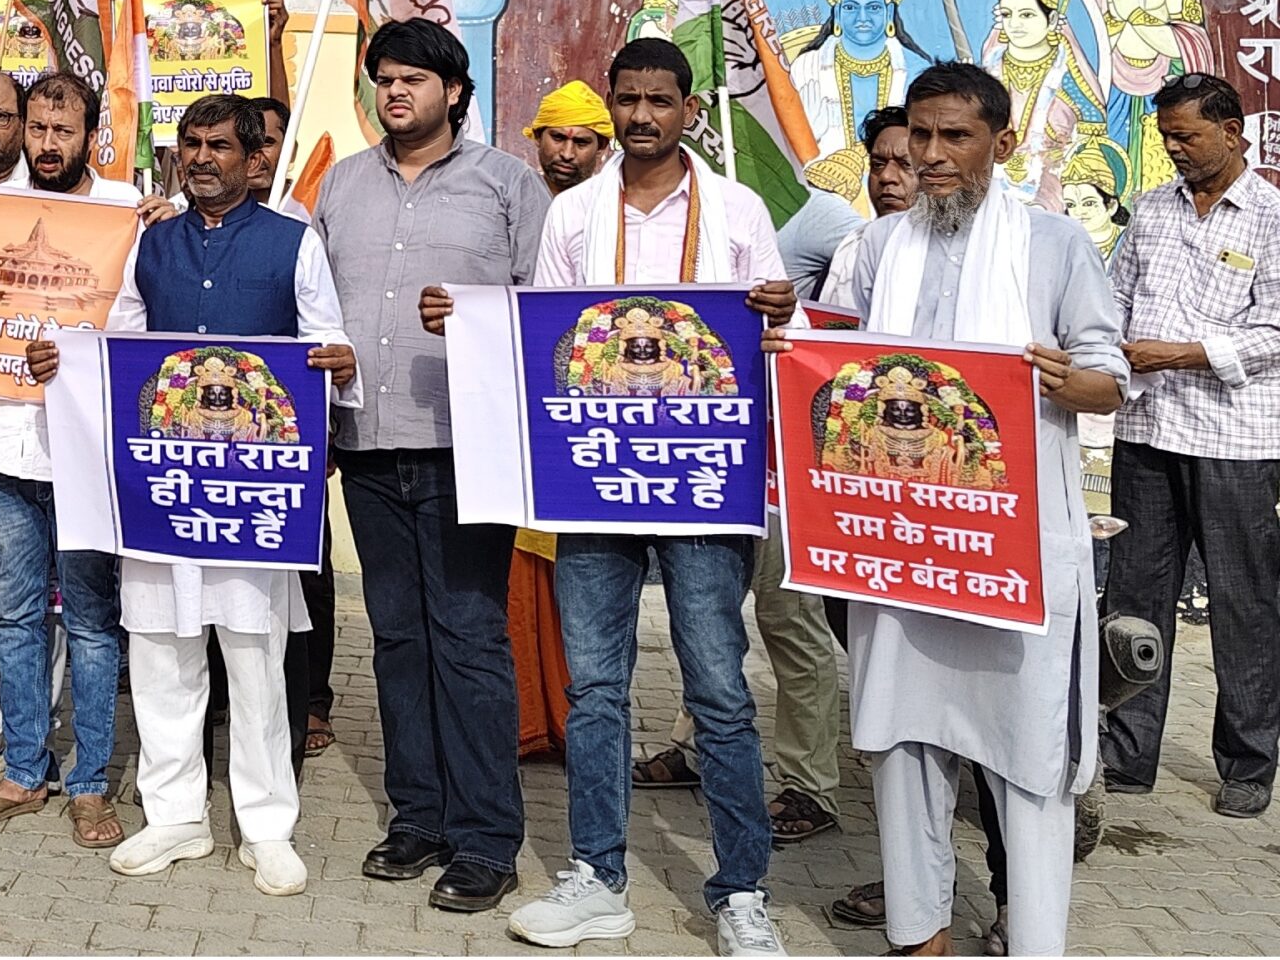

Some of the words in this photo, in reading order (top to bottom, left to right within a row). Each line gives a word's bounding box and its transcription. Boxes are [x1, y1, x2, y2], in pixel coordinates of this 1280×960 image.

[1237, 38, 1280, 84] रा
[97, 88, 115, 167] RESS
[542, 387, 658, 426] चंपत
[666, 397, 753, 426] राय
[127, 431, 228, 468] चंपत
[236, 442, 313, 472] राय
[567, 428, 620, 468] ही
[628, 438, 747, 468] चन्दा
[147, 469, 193, 508] ही
[201, 480, 305, 512] चन्दा
[592, 468, 679, 505] चोर
[687, 466, 728, 509] हैं
[808, 468, 904, 503] भाजपा
[909, 479, 1019, 518] सरकार
[168, 508, 243, 545] चोर
[251, 508, 287, 549] हैं
[834, 510, 886, 541] राम
[890, 511, 926, 545] के
[931, 524, 995, 557] नाम
[807, 546, 848, 575] पर
[852, 552, 904, 592] लूट
[908, 557, 959, 595] बंद
[964, 569, 1029, 604] करो
